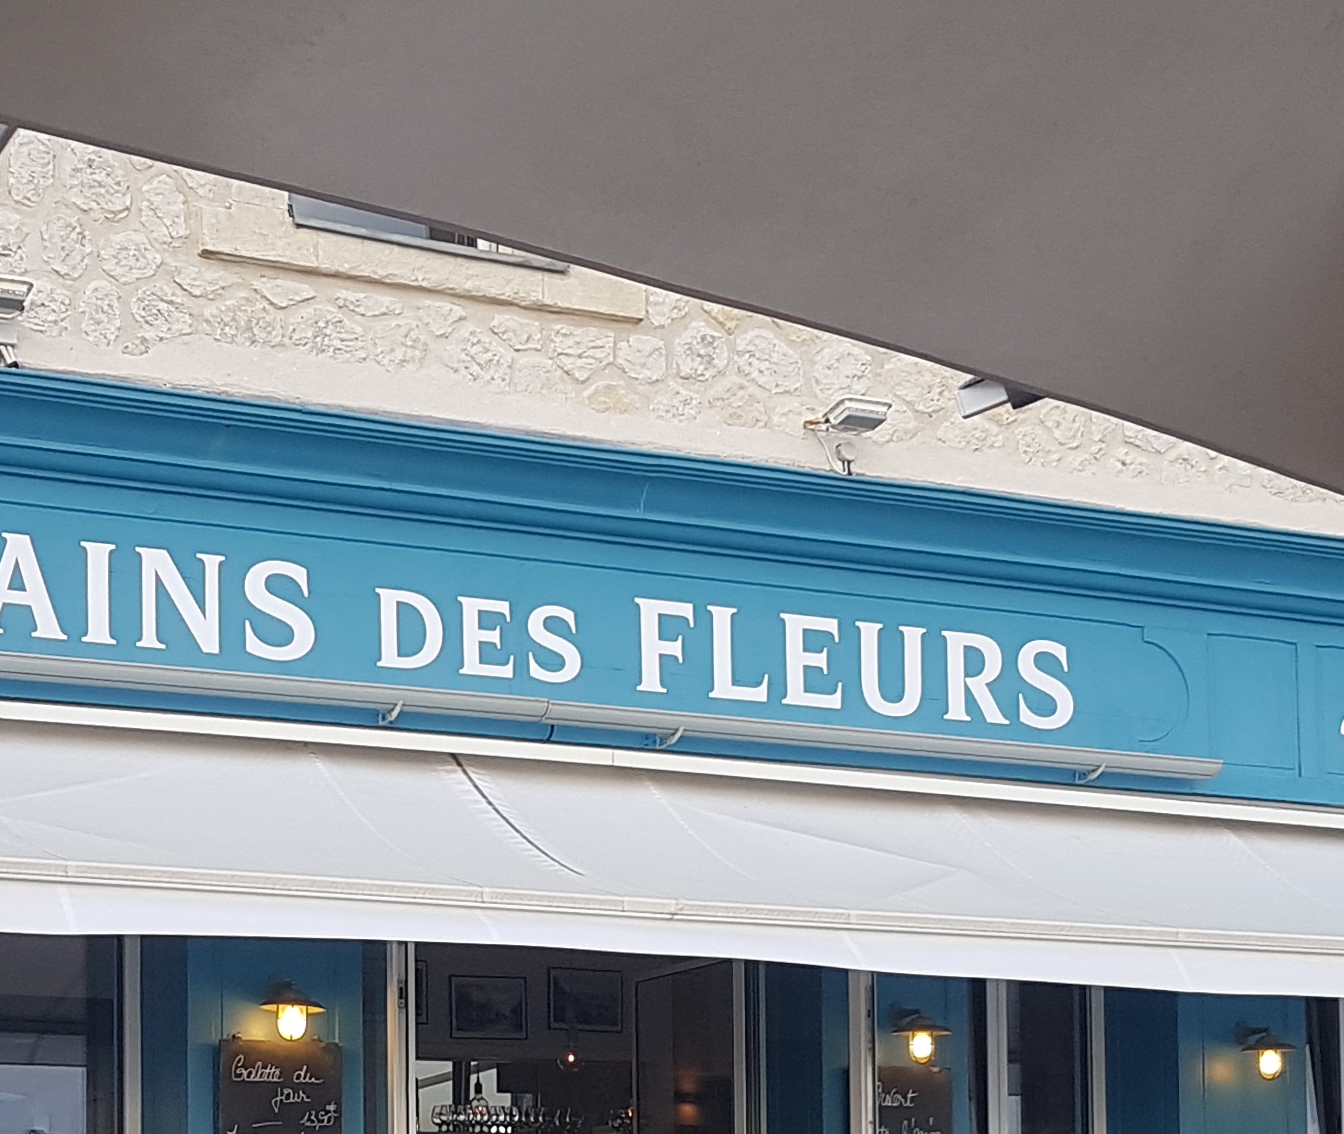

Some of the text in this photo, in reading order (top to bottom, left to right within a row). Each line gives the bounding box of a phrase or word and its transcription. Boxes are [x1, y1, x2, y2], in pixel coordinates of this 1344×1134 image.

[374, 586, 583, 684] DES
[633, 596, 1075, 730] FLEURS
[231, 1054, 324, 1083] Galette du
